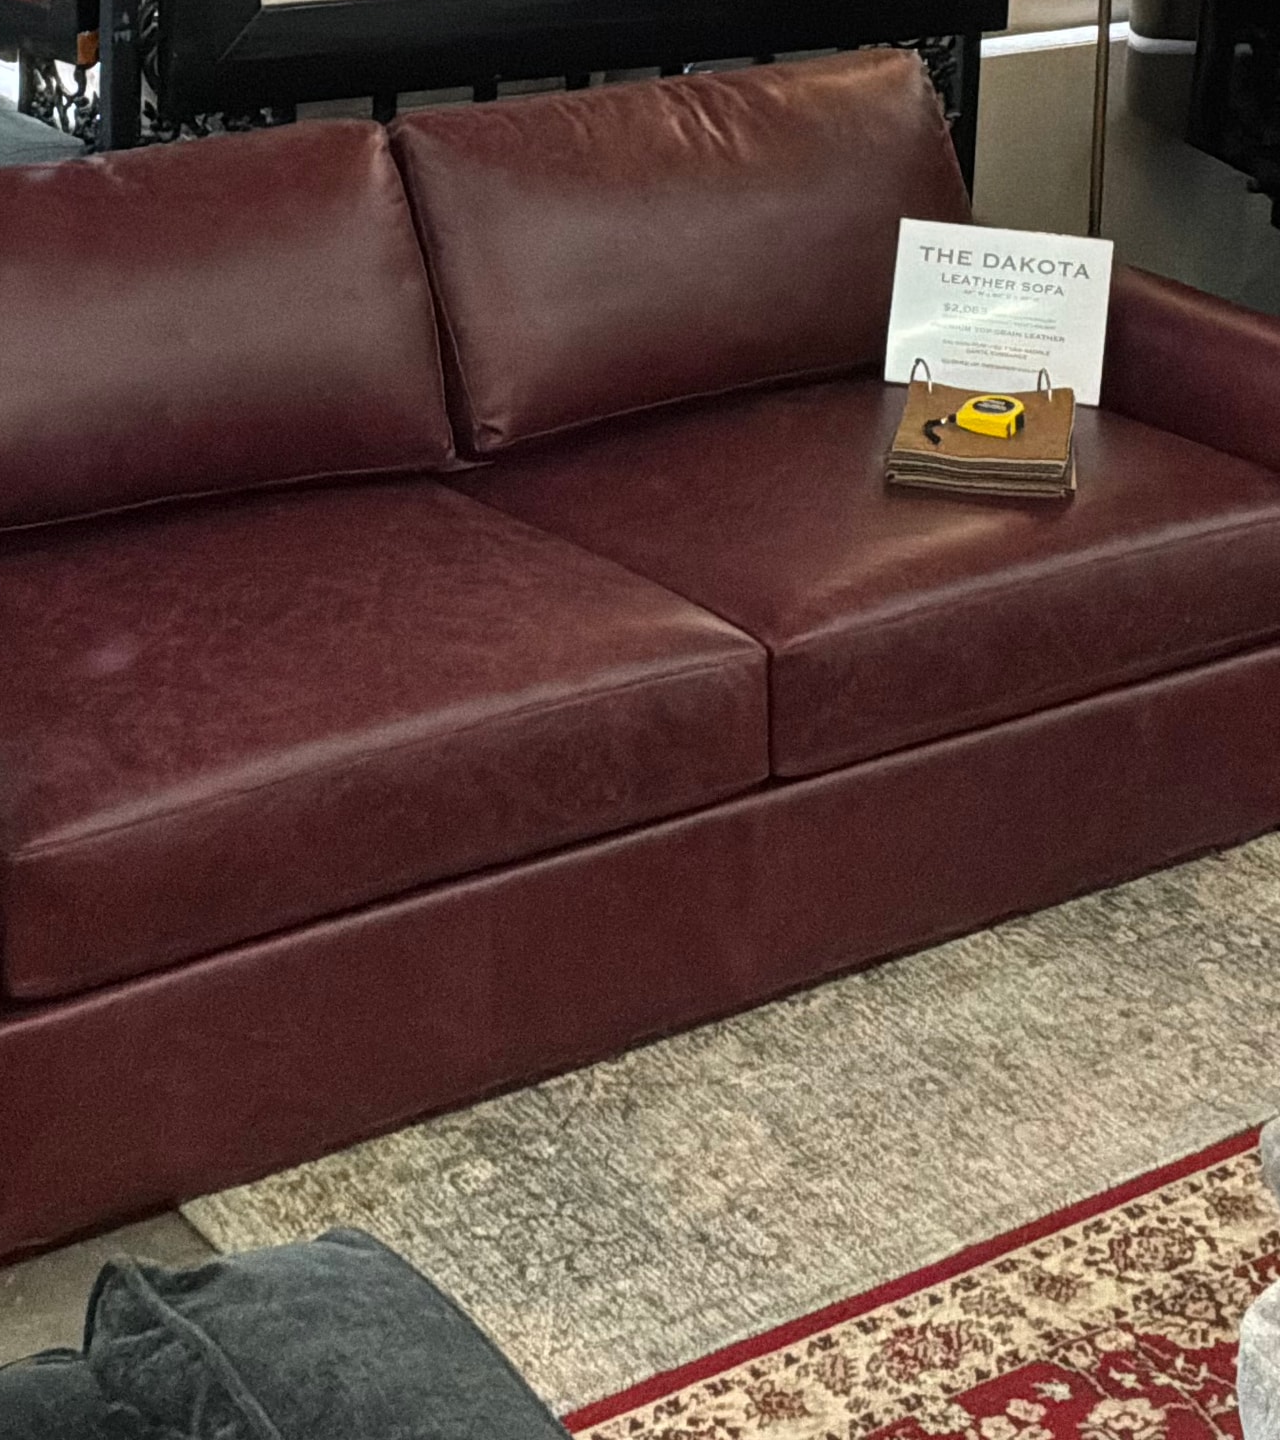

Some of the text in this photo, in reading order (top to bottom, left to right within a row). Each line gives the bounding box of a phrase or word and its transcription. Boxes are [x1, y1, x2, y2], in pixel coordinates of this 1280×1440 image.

[920, 246, 1090, 280] THE DAKOTA
[941, 272, 1016, 291] LEATHER
[1021, 281, 1065, 297] SOFA
[1024, 332, 1066, 344] LEATHER
